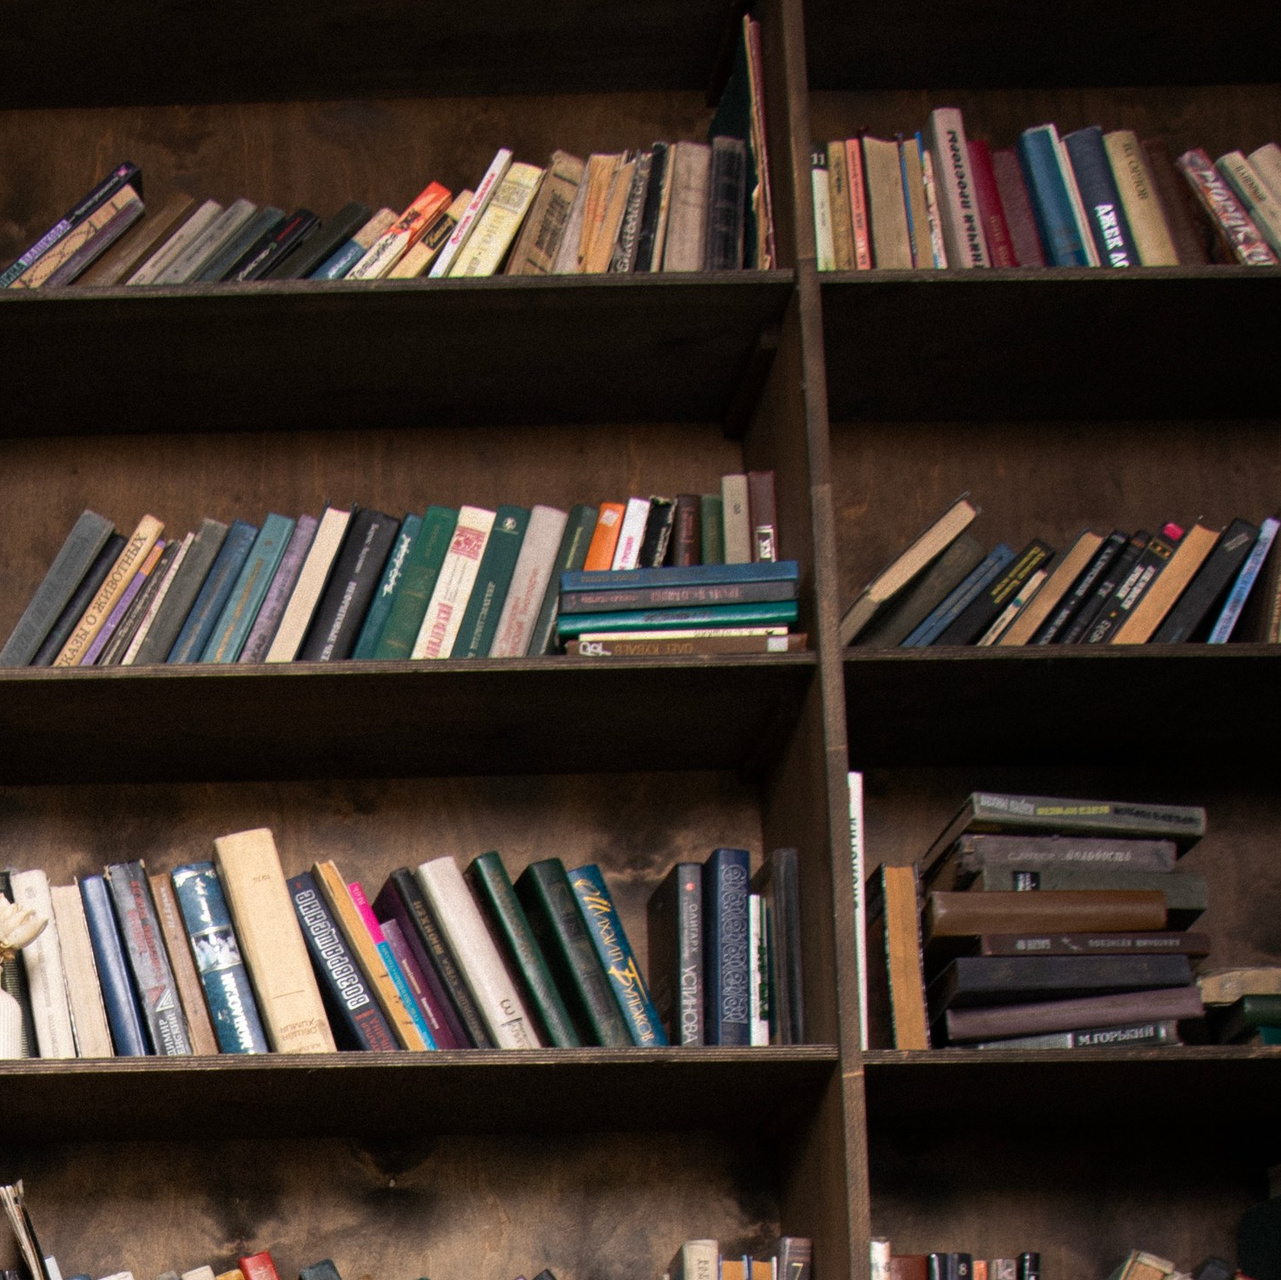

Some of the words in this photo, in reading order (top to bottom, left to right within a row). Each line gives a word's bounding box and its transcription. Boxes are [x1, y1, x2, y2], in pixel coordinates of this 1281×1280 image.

[88, 530, 151, 614] ЖИВОТНЫХ
[219, 972, 254, 1050] МОПАССАН
[679, 964, 698, 1044] УСТИНОВА
[1077, 1025, 1155, 1045] М.ГОРЬКИЙ
[791, 1262, 803, 1280] 7
[957, 1262, 967, 1276] 8
